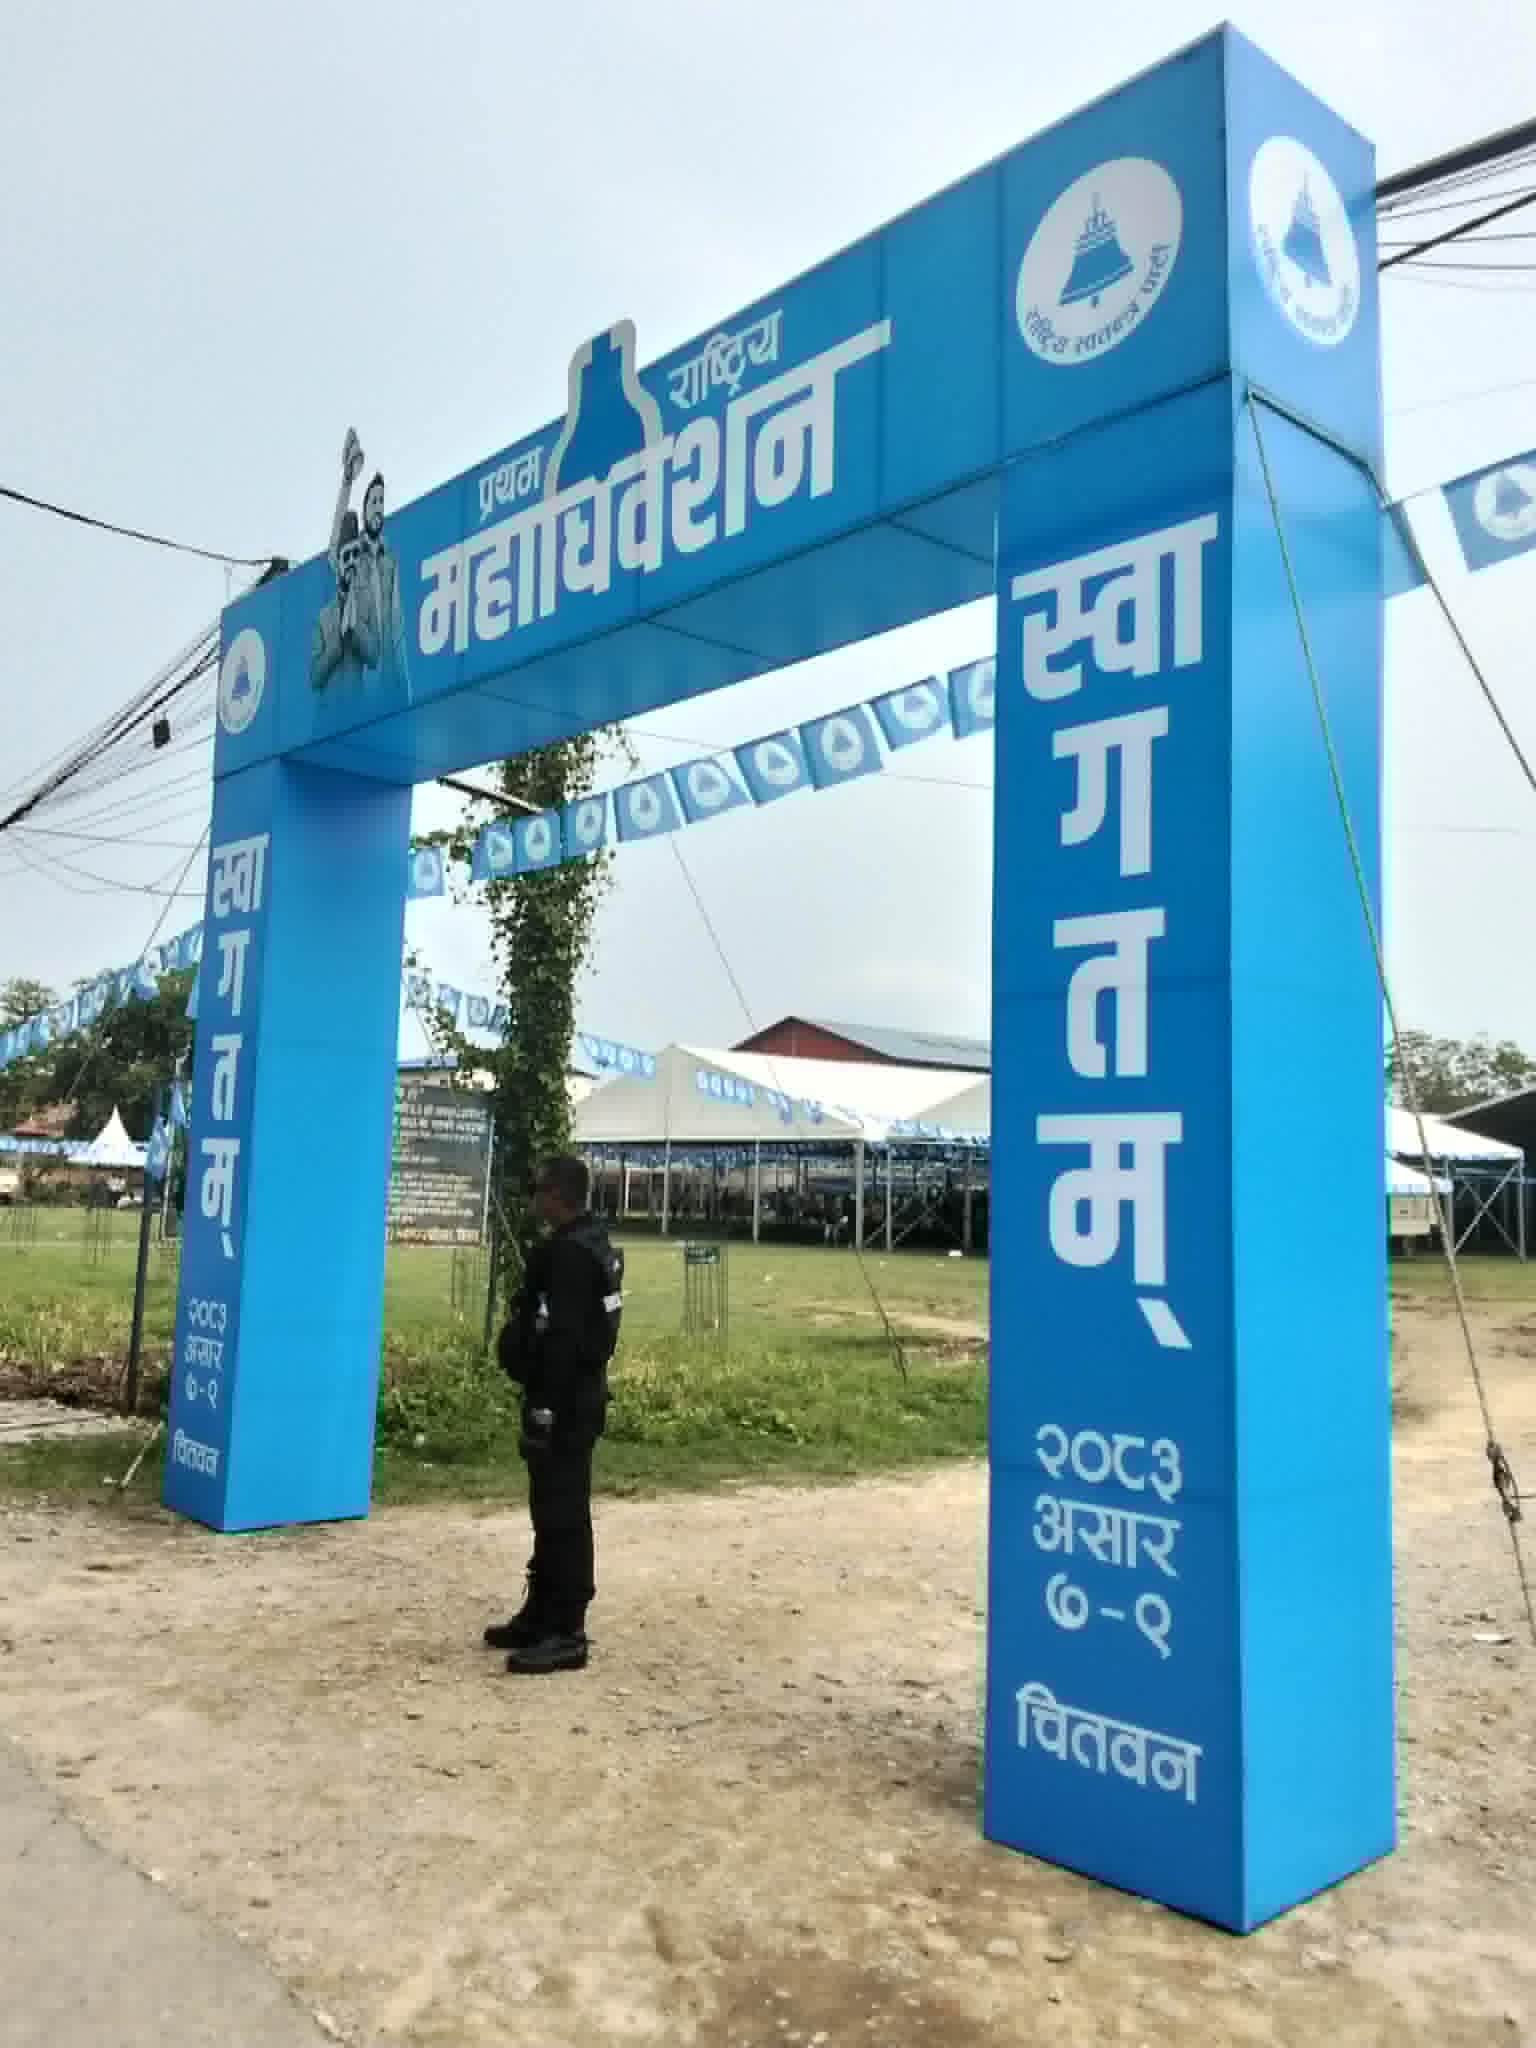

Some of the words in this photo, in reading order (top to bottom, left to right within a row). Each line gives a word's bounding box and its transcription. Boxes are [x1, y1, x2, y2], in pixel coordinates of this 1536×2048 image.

[479, 445, 544, 521] प्रथम
[1035, 1424, 1184, 1503] २०८३
[1032, 1494, 1182, 1579] असार
[1015, 1682, 1203, 1804] चितवन
